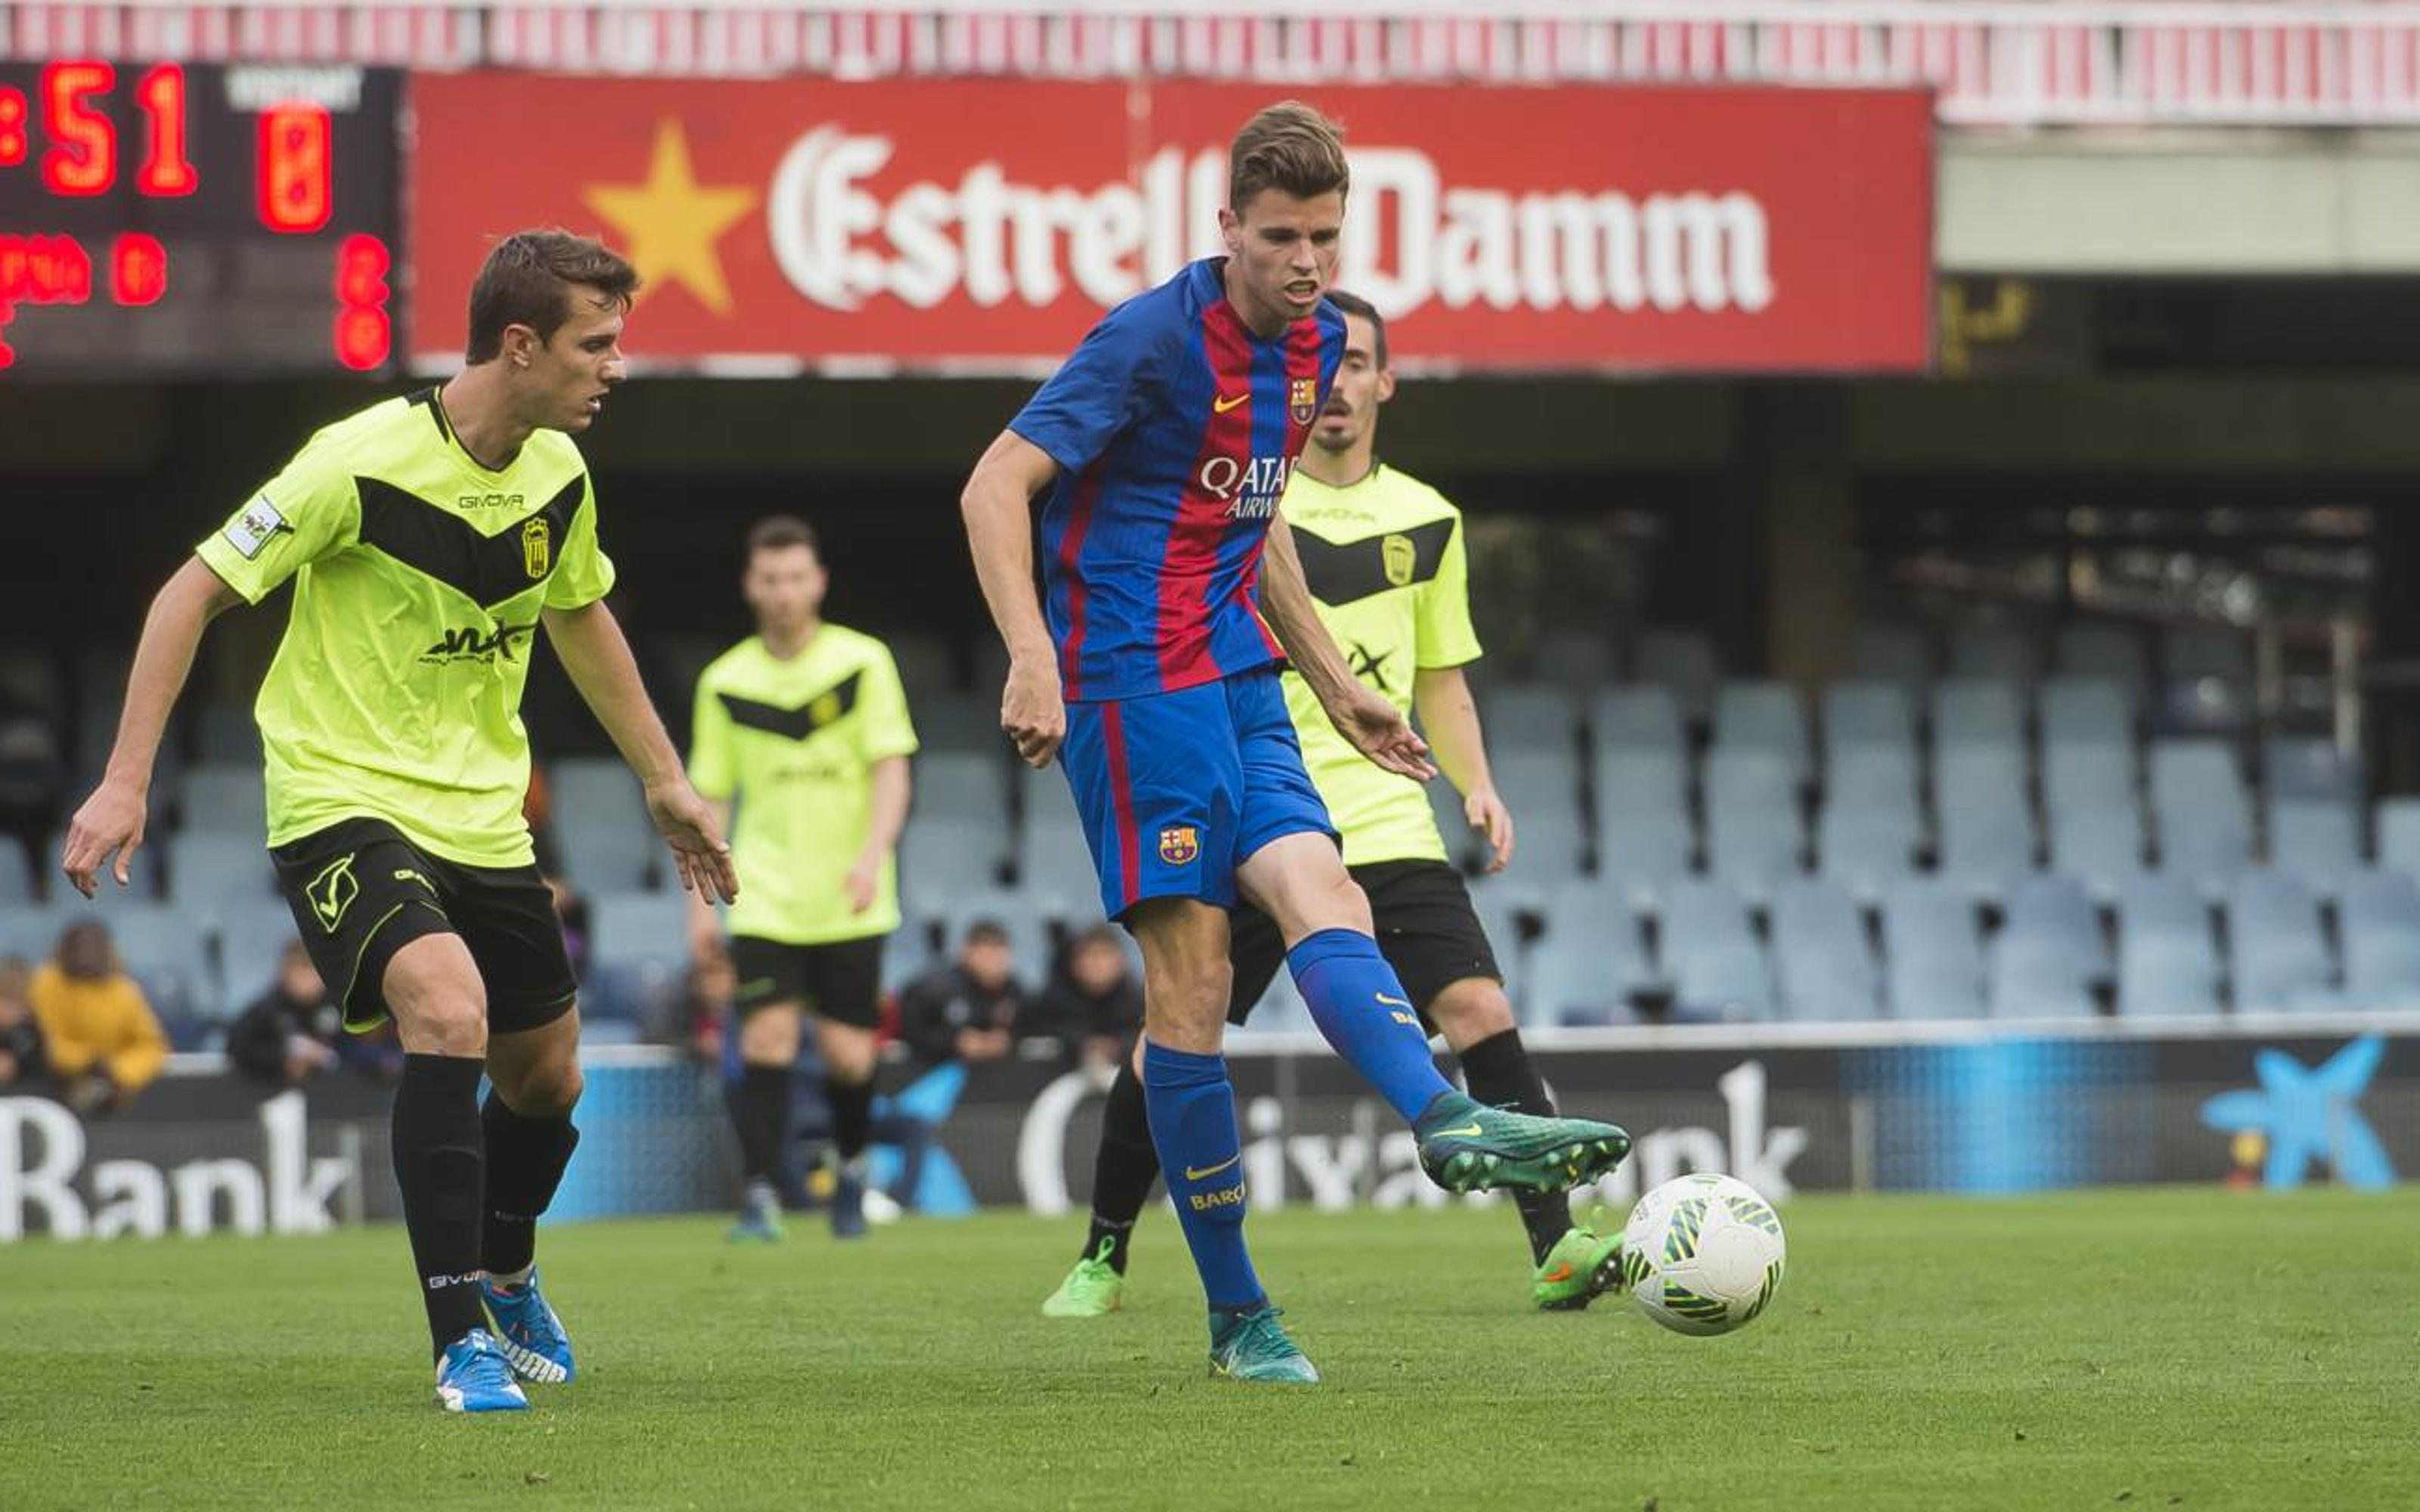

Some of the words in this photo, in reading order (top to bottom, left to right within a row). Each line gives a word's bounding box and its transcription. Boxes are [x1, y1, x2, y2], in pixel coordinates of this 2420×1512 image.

[768, 125, 1230, 311] Estrell
[1339, 146, 1776, 321] Damm
[458, 494, 525, 509] GIVOVA
